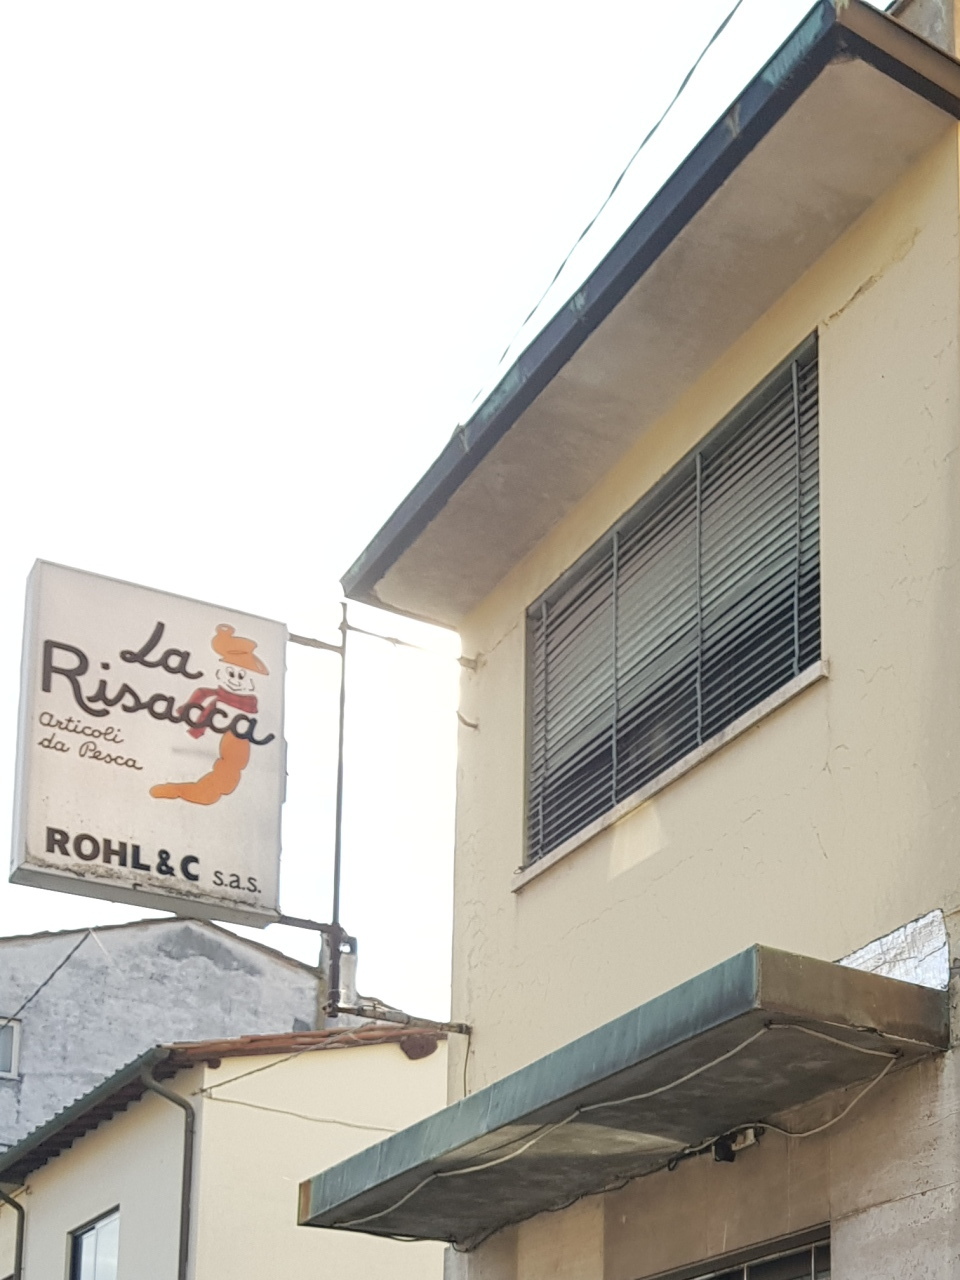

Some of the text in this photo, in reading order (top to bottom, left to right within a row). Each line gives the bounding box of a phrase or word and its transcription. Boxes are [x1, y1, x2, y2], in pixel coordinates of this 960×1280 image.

[120, 621, 204, 680] La
[41, 638, 276, 746] Risacca
[37, 732, 144, 771] da Pesca
[45, 826, 262, 894] ROHL&C s.a.s.
